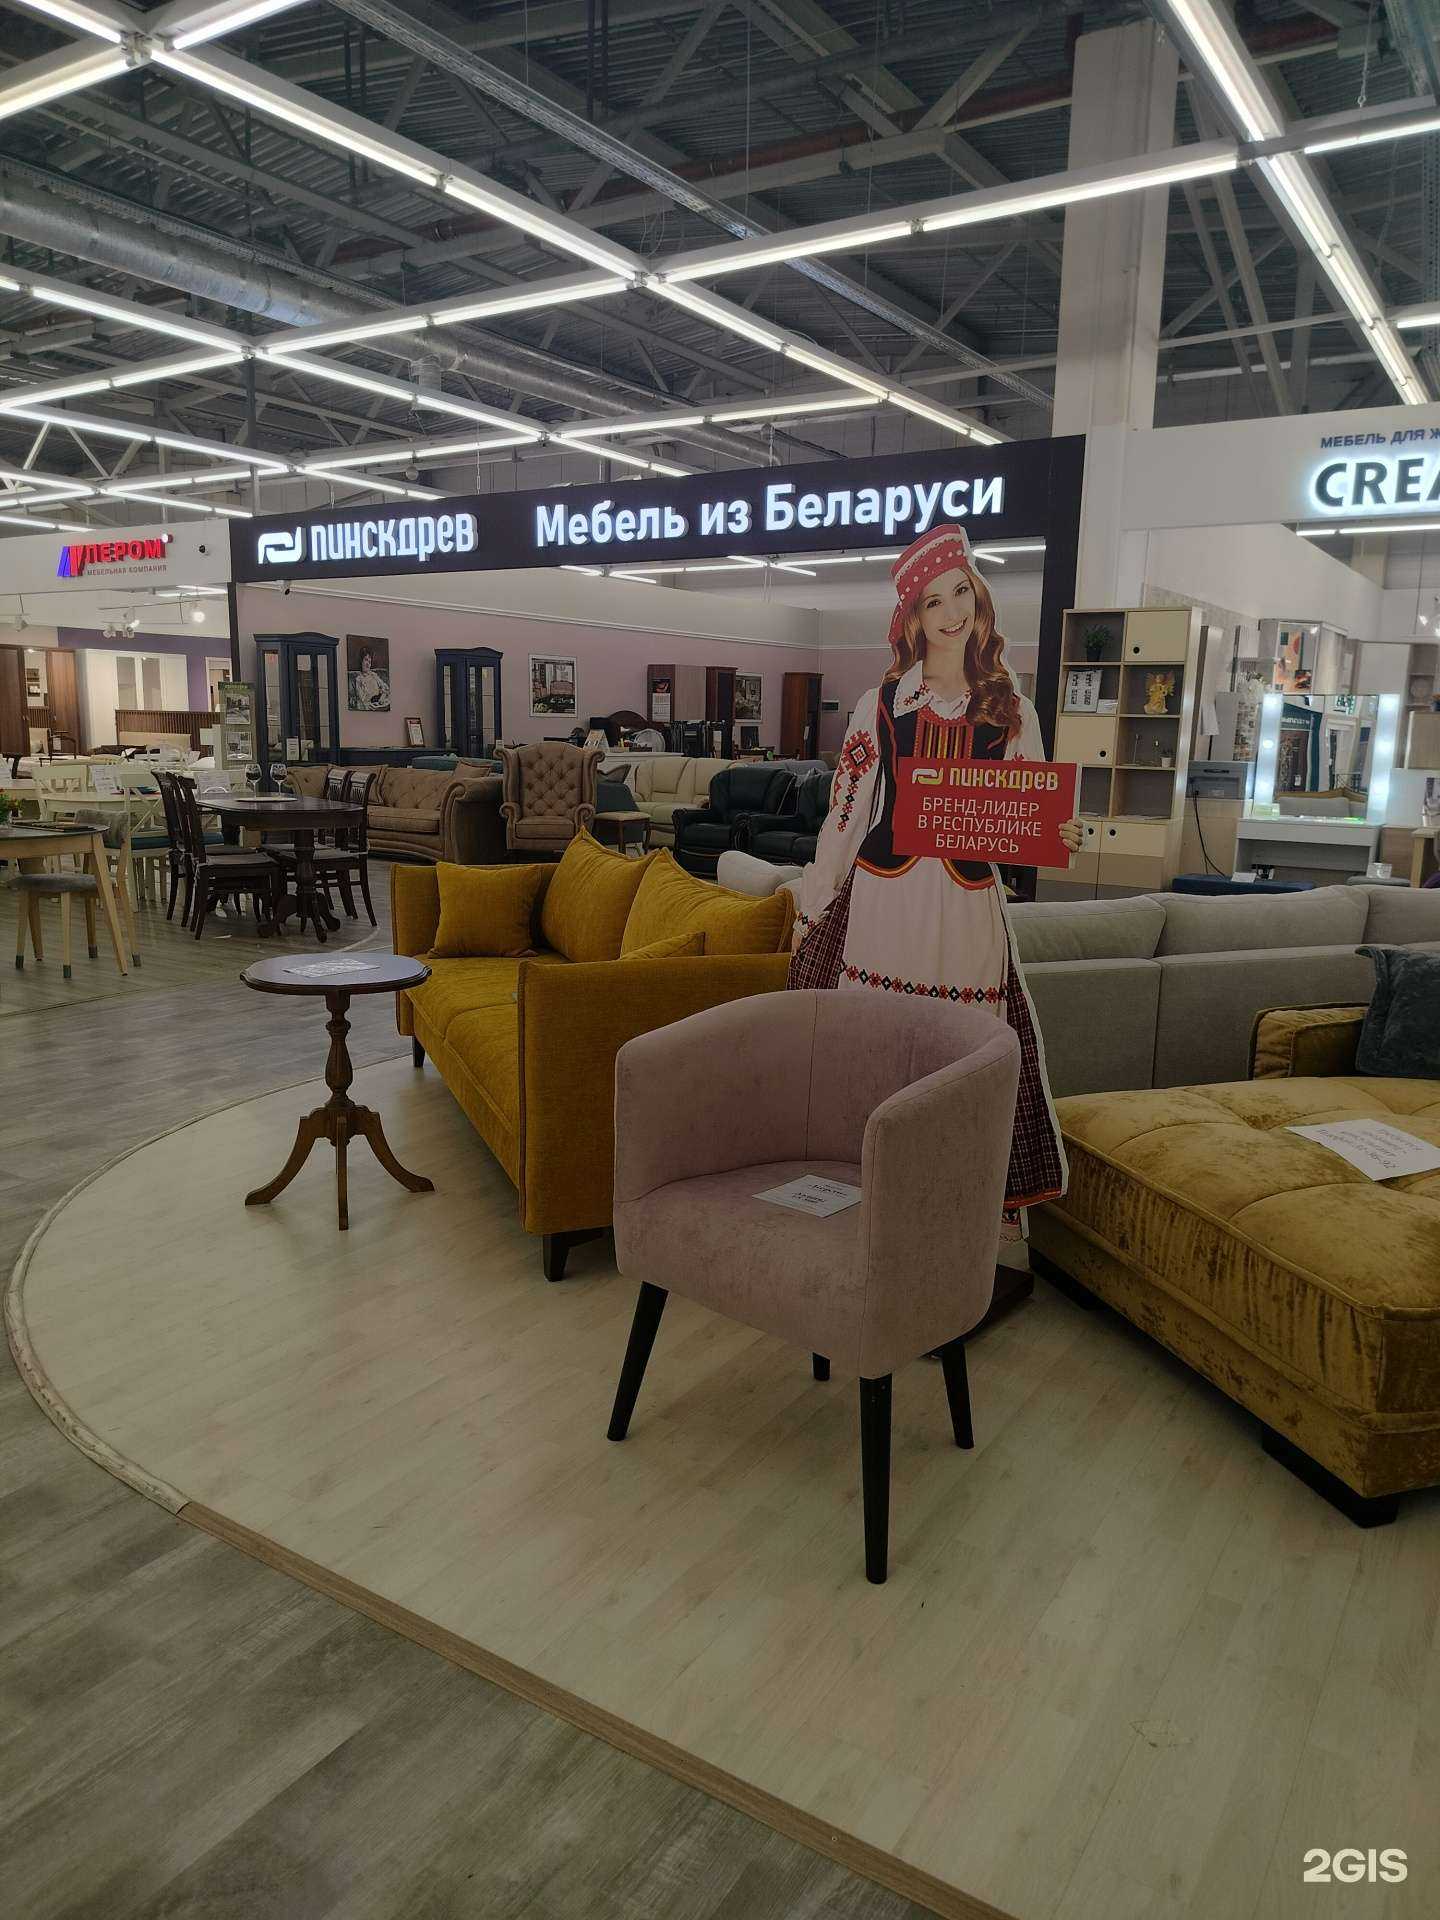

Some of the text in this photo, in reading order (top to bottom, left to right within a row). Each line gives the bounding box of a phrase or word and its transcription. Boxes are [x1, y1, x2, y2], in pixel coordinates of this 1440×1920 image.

[1320, 432, 1386, 448] МЕБЕЛЬ
[1391, 428, 1425, 445] ДЛЯ
[535, 476, 1004, 547] Мебель из Беларуси
[922, 796, 1040, 819] БРЕНД-ЛИДЕР
[917, 814, 1042, 837] В РЕСПУБЛИКЕ
[935, 833, 1019, 853] БЕЛАРУСЬ
